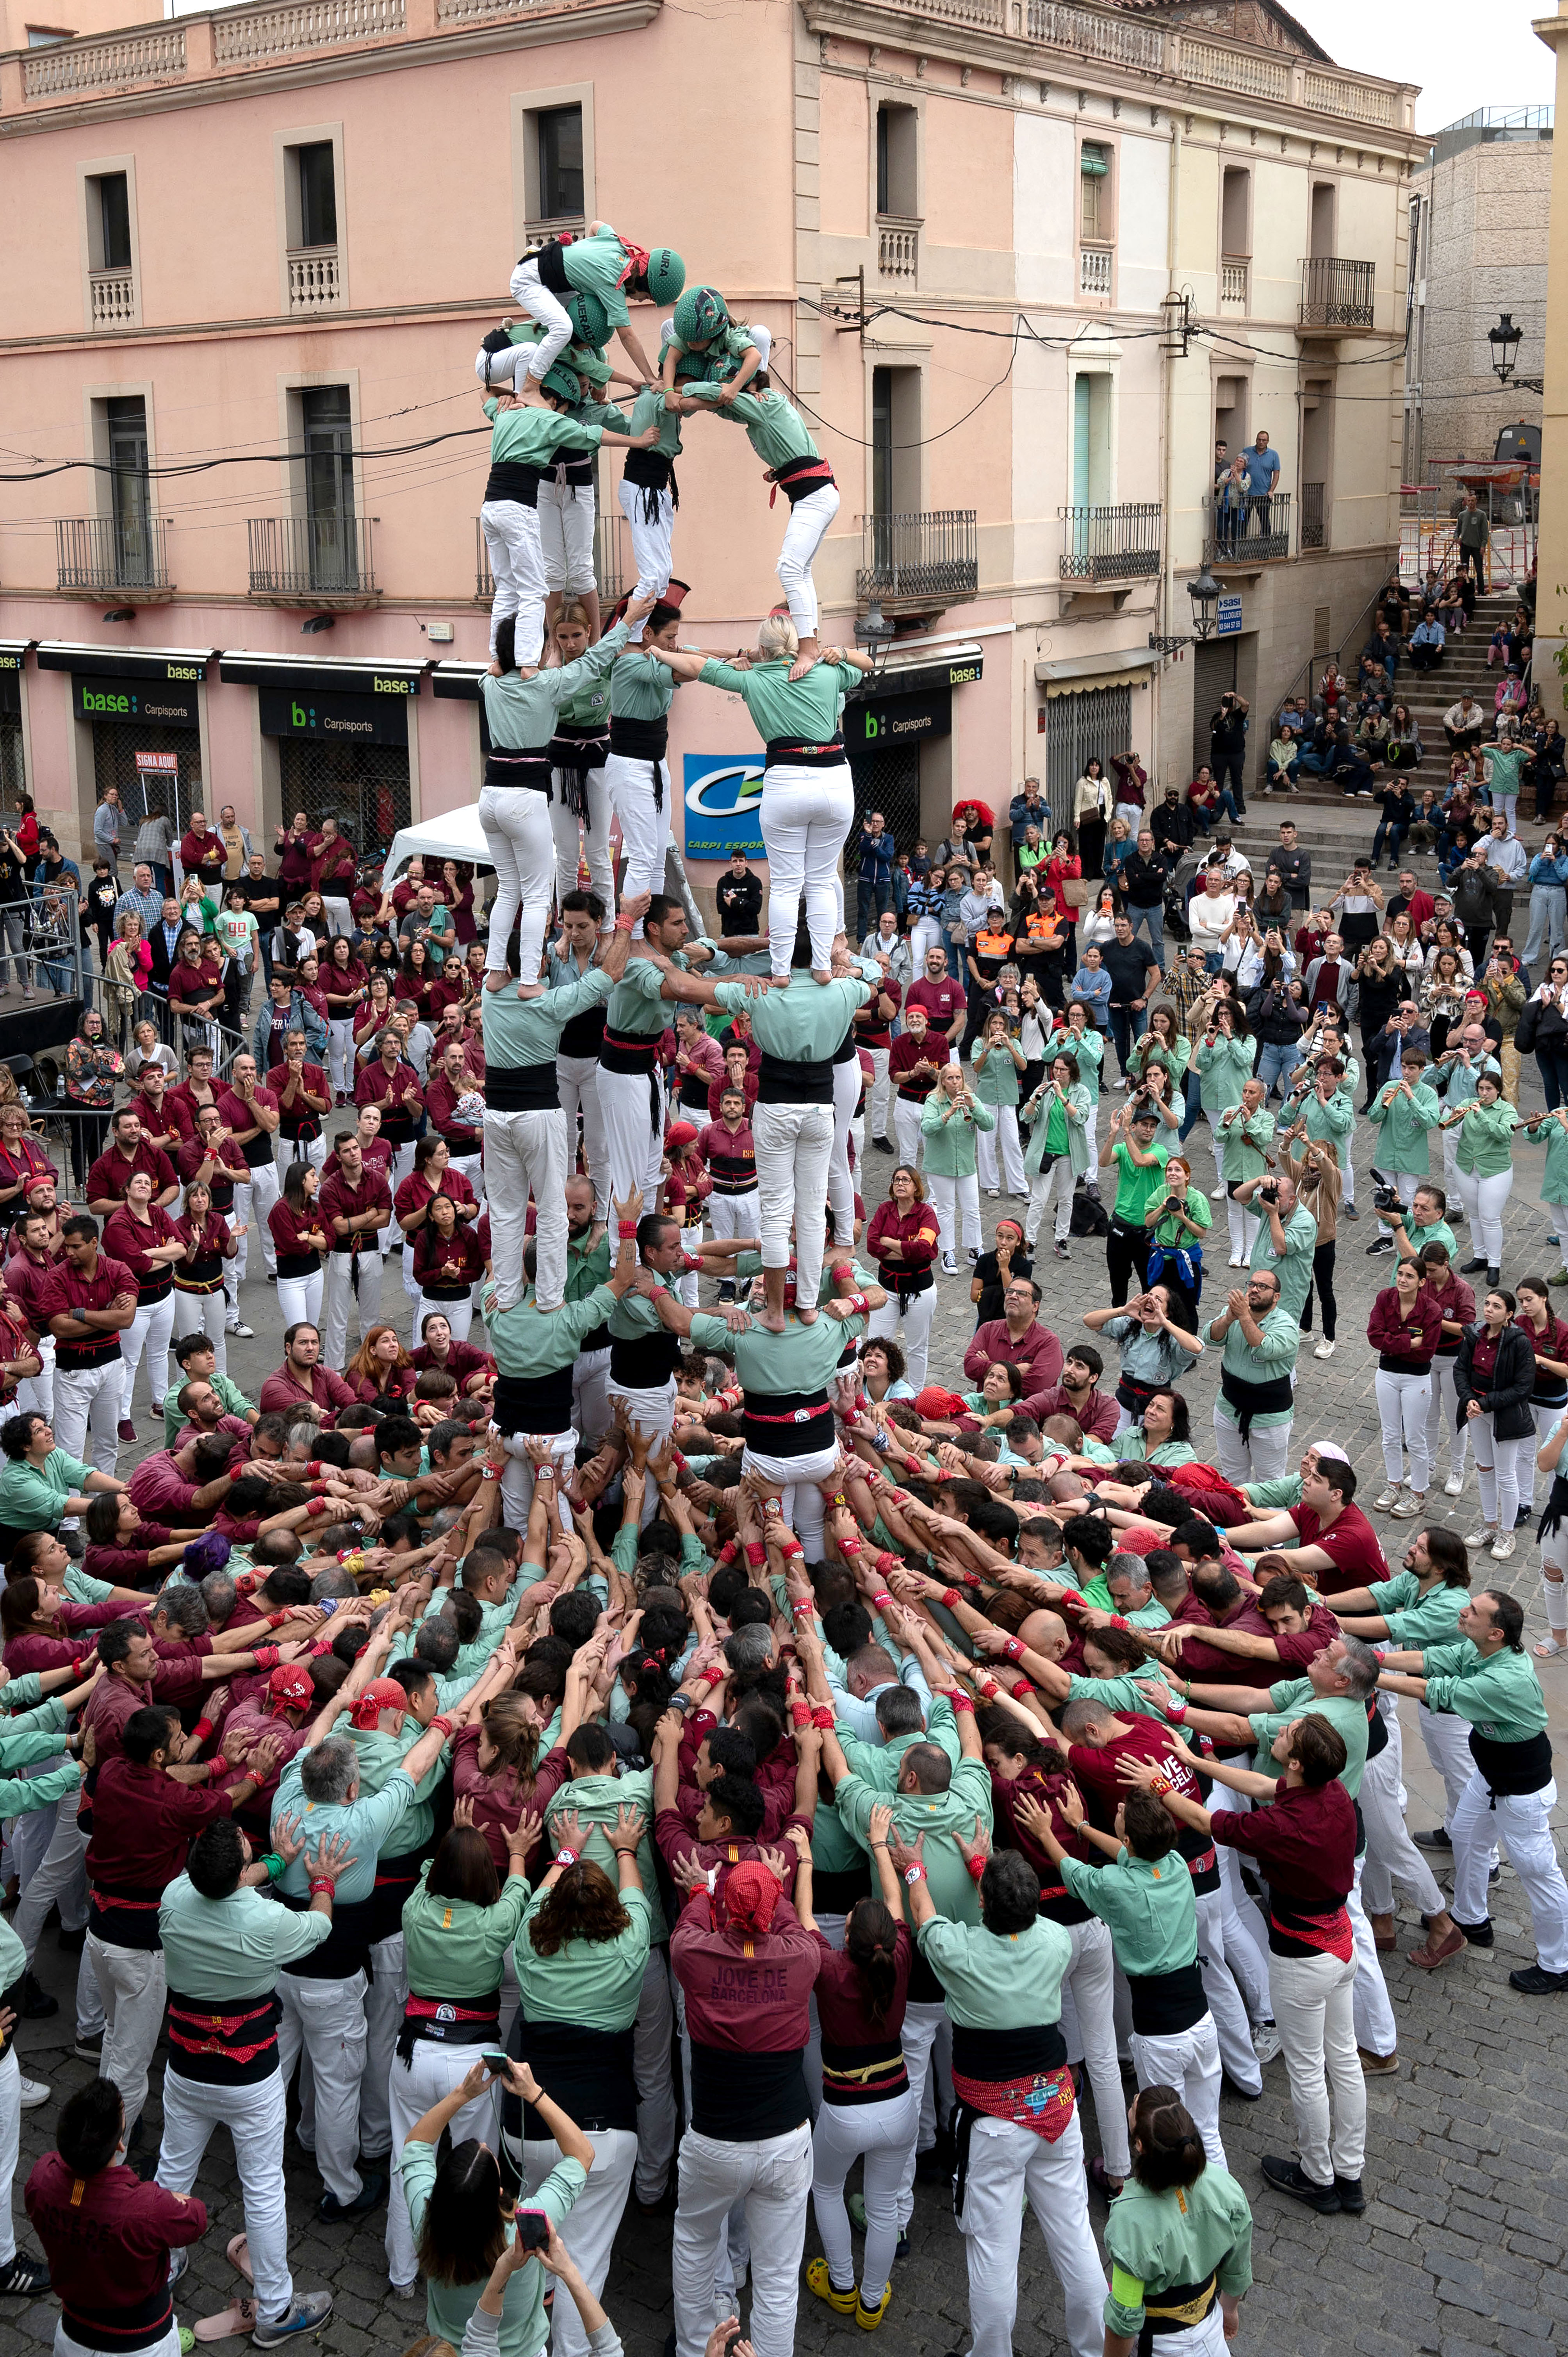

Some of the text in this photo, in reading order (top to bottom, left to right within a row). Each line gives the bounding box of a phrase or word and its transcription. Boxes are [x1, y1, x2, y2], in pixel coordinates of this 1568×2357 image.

[659, 249, 671, 277] AURA
[576, 294, 595, 341] QUERALT
[1224, 610, 1242, 620] LLOGUER
[1219, 623, 1223, 631] 93
[145, 704, 188, 717] Carpisports
[324, 717, 373, 733] Carpisports
[892, 716, 932, 733] Carpisports
[137, 754, 176, 768] SIGNA AQUÍ!
[688, 840, 764, 851] CARPI ESPOR
[712, 1966, 787, 1989] JOVE DE
[711, 1986, 787, 2004] BARCELONA
